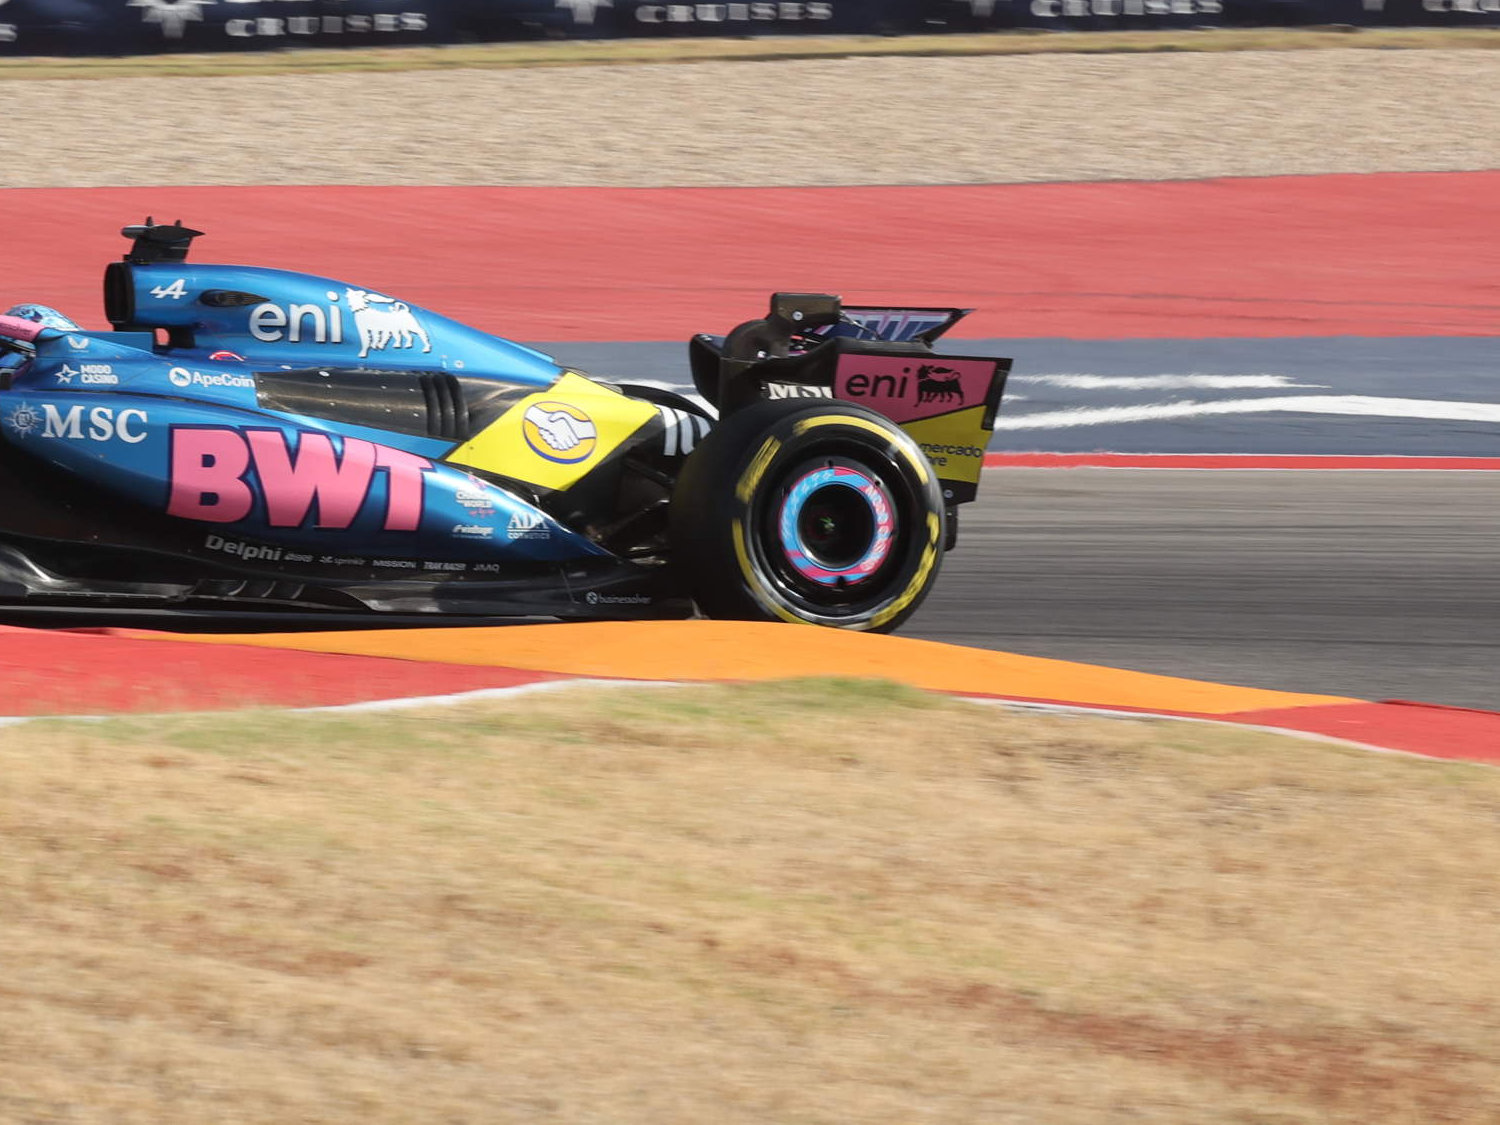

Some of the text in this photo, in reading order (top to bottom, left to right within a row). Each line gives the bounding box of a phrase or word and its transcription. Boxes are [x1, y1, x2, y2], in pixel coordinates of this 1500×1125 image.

[224, 11, 428, 37] CRUISES
[634, 2, 833, 24] CRUISES
[249, 291, 342, 343] eni
[193, 371, 255, 388] ApeCoin
[846, 367, 911, 398] eni
[41, 403, 149, 444] MSC
[166, 425, 436, 532] BWT
[506, 512, 550, 529] ADA
[204, 534, 283, 561] Delphi
[372, 559, 417, 569] MISSION
